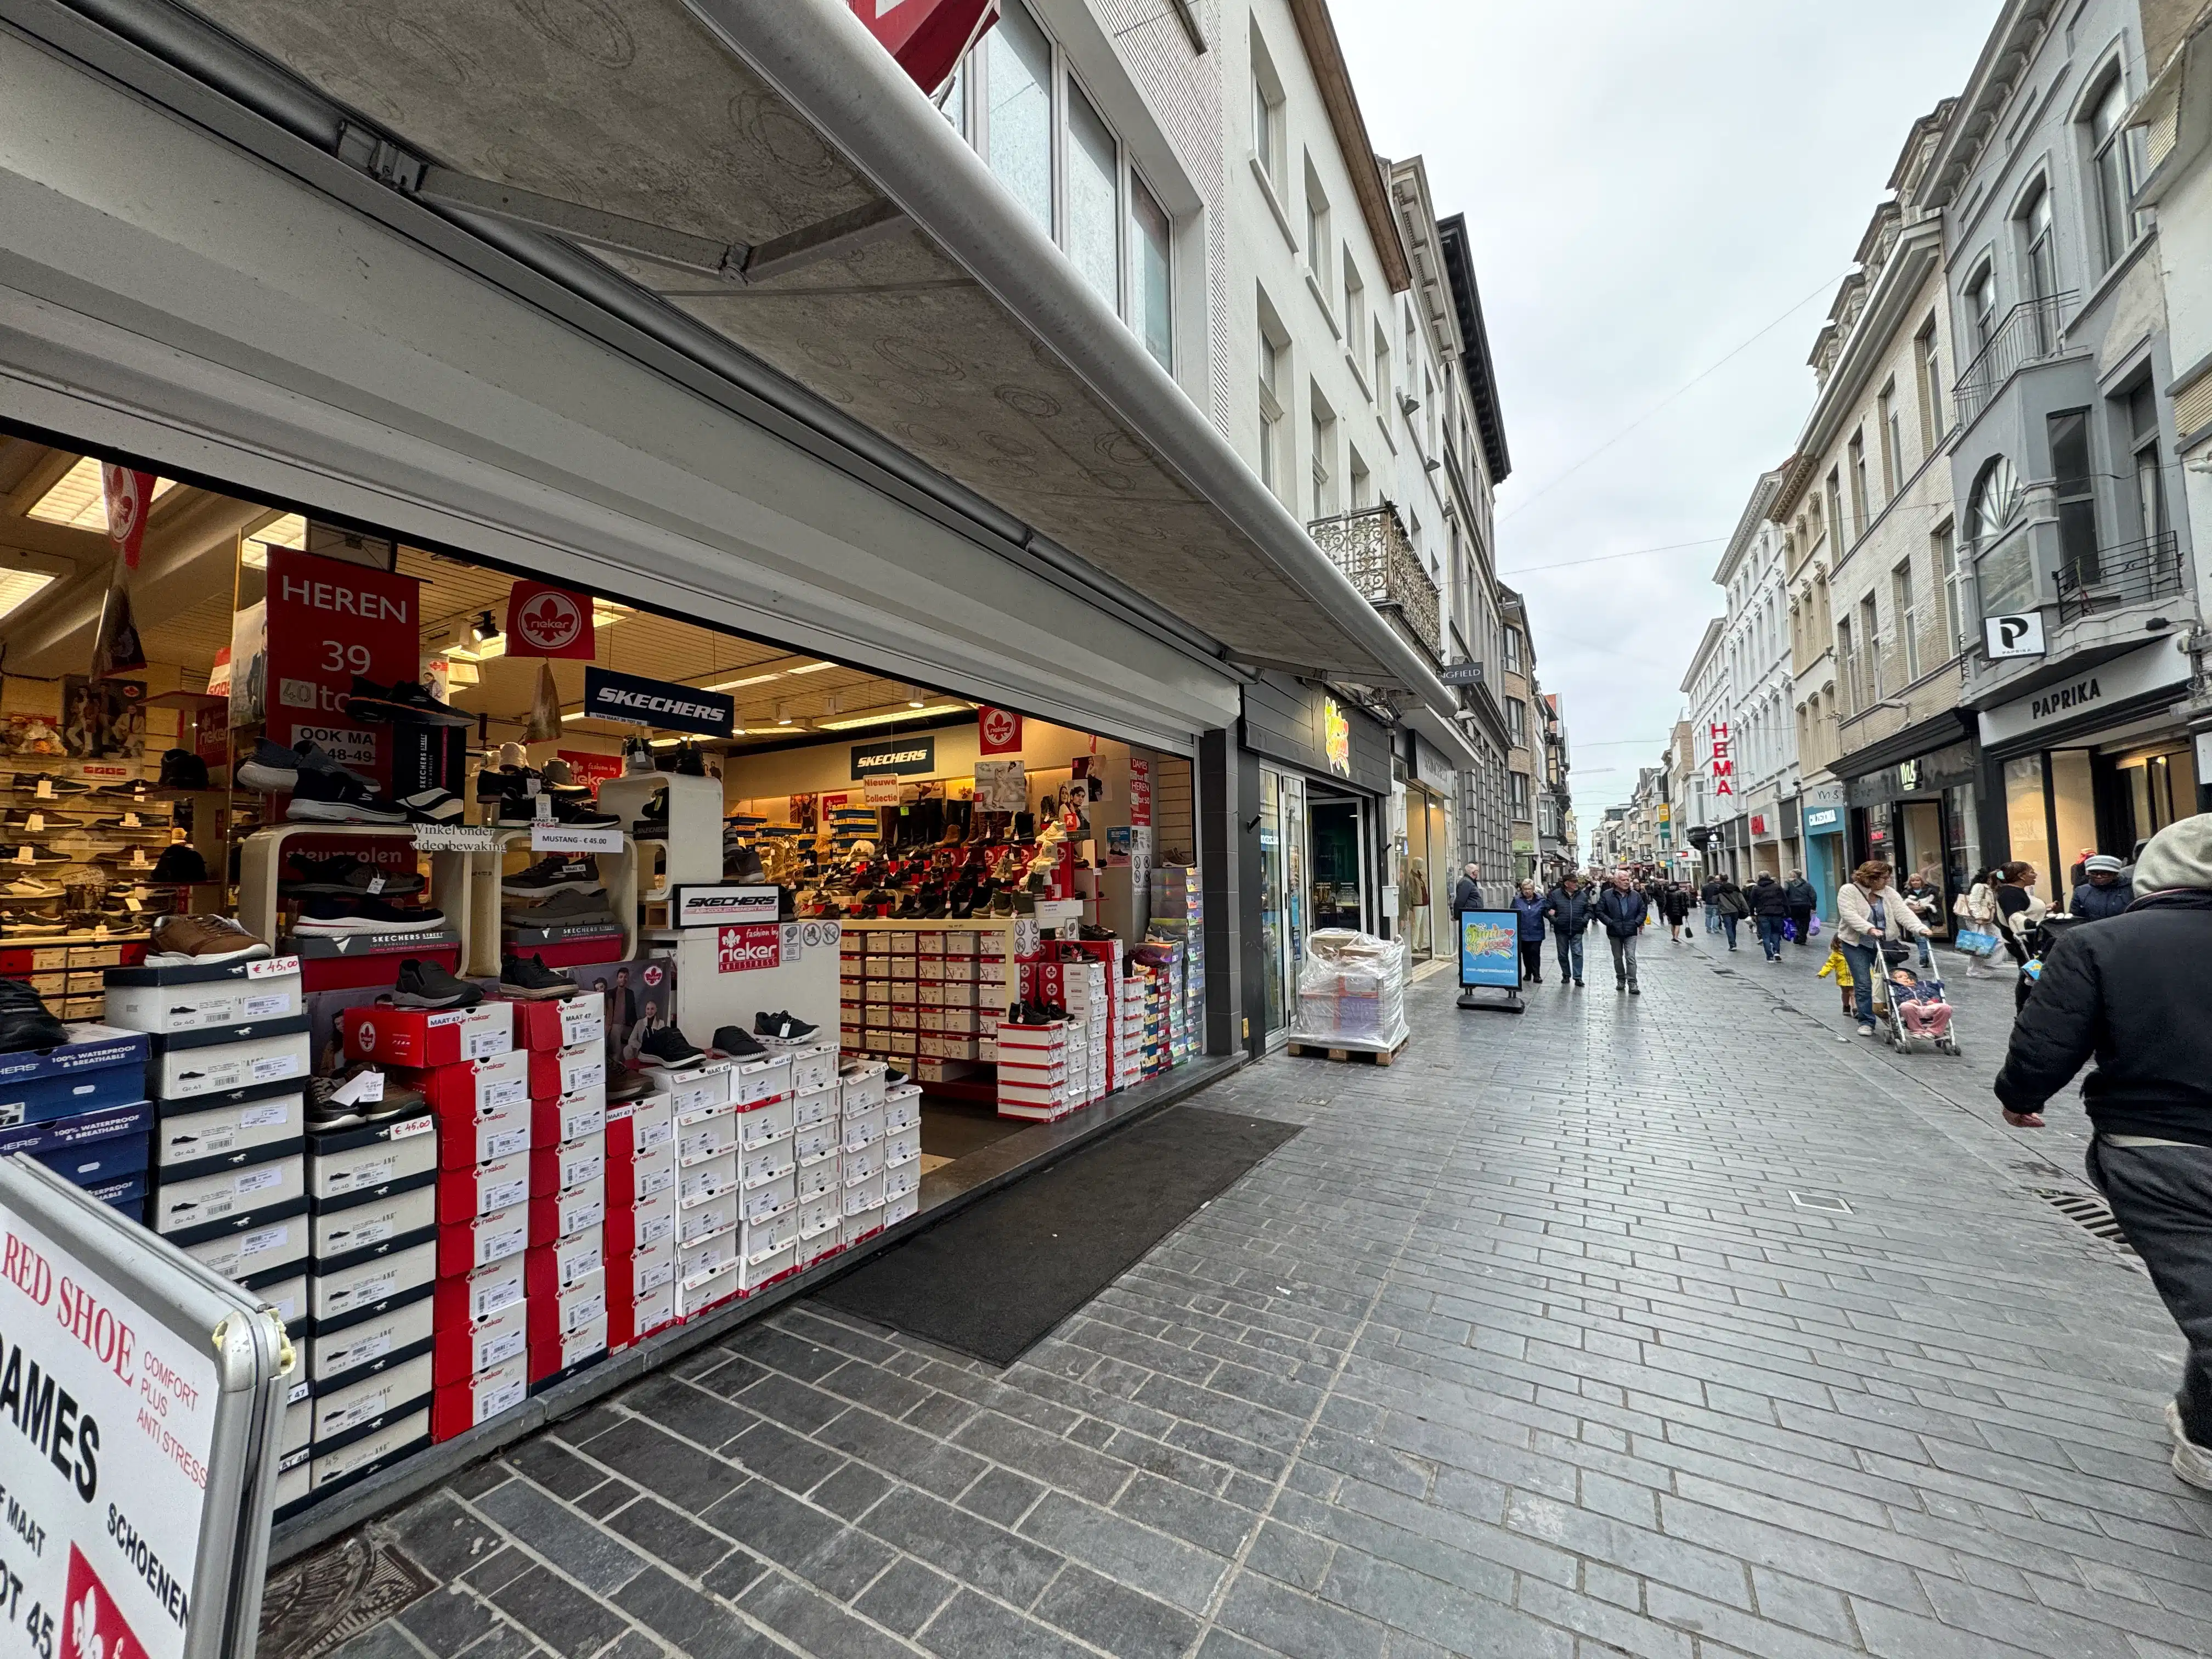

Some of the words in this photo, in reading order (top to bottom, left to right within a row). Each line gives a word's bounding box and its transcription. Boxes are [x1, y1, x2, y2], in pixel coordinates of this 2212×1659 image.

[283, 575, 406, 623] HEREN
[321, 641, 371, 675] 39
[1441, 669, 1481, 679] NGFIELD
[597, 687, 725, 721] SKECHERS
[2032, 679, 2101, 720] PAPRIKA
[300, 727, 342, 742] OOK
[857, 749, 927, 768] SKECHERS
[1132, 759, 1148, 770] DAMES
[1711, 722, 1733, 796] HEMA
[1132, 781, 1149, 792] HEREN
[866, 793, 898, 803] Collectie
[411, 823, 456, 836] Winkel
[460, 826, 494, 836] onder
[542, 835, 578, 843] MUSTANG
[685, 896, 777, 907] SKECHERS
[373, 934, 420, 943] SKECHERS
[746, 929, 769, 938] fashion
[771, 928, 779, 939] by
[719, 942, 777, 962] rieker
[720, 959, 777, 970] ANTISTRESS
[431, 1018, 450, 1026] MAAT
[566, 1014, 582, 1022] MAAT
[52, 1054, 75, 1063] 100%
[78, 1045, 136, 1059] WATERPROOF
[72, 1053, 126, 1067] BREATHABLE
[707, 1066, 721, 1075] MAAT
[607, 1111, 622, 1120] MAAT
[54, 1127, 79, 1137] 100%
[81, 1114, 140, 1131] WATERPROOF
[75, 1123, 129, 1139] BREATHABLE
[1, 1231, 52, 1306] RED
[57, 1276, 136, 1387] SHOE
[144, 1351, 199, 1412] COMFORT
[141, 1379, 167, 1418] PLUS
[295, 1389, 306, 1399] 47
[0, 1331, 100, 1504] AMES
[137, 1407, 161, 1444] ANTI
[162, 1431, 207, 1489] STRESS
[297, 1453, 308, 1462] 48
[7, 1496, 46, 1558] MAAT
[108, 1502, 188, 1629] SCHOENEN
[26, 1601, 54, 1659] 45
